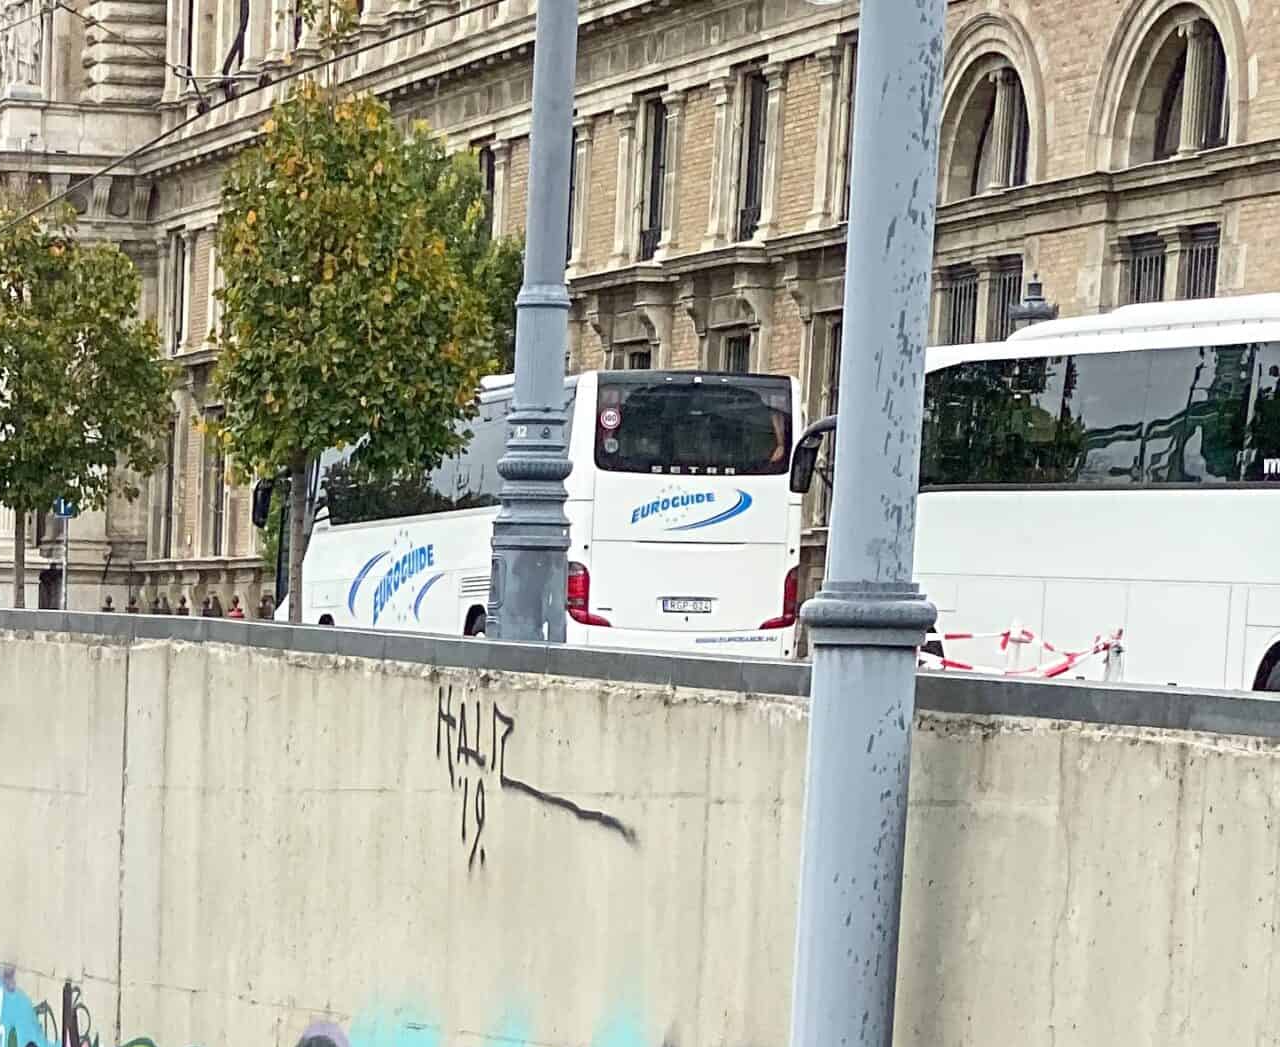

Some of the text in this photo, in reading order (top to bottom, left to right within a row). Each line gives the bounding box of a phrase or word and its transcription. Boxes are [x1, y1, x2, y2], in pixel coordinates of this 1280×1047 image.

[651, 465, 735, 475] SETRA
[631, 491, 716, 524] EUROGUIDE
[373, 543, 434, 627] EUROGUIDE
